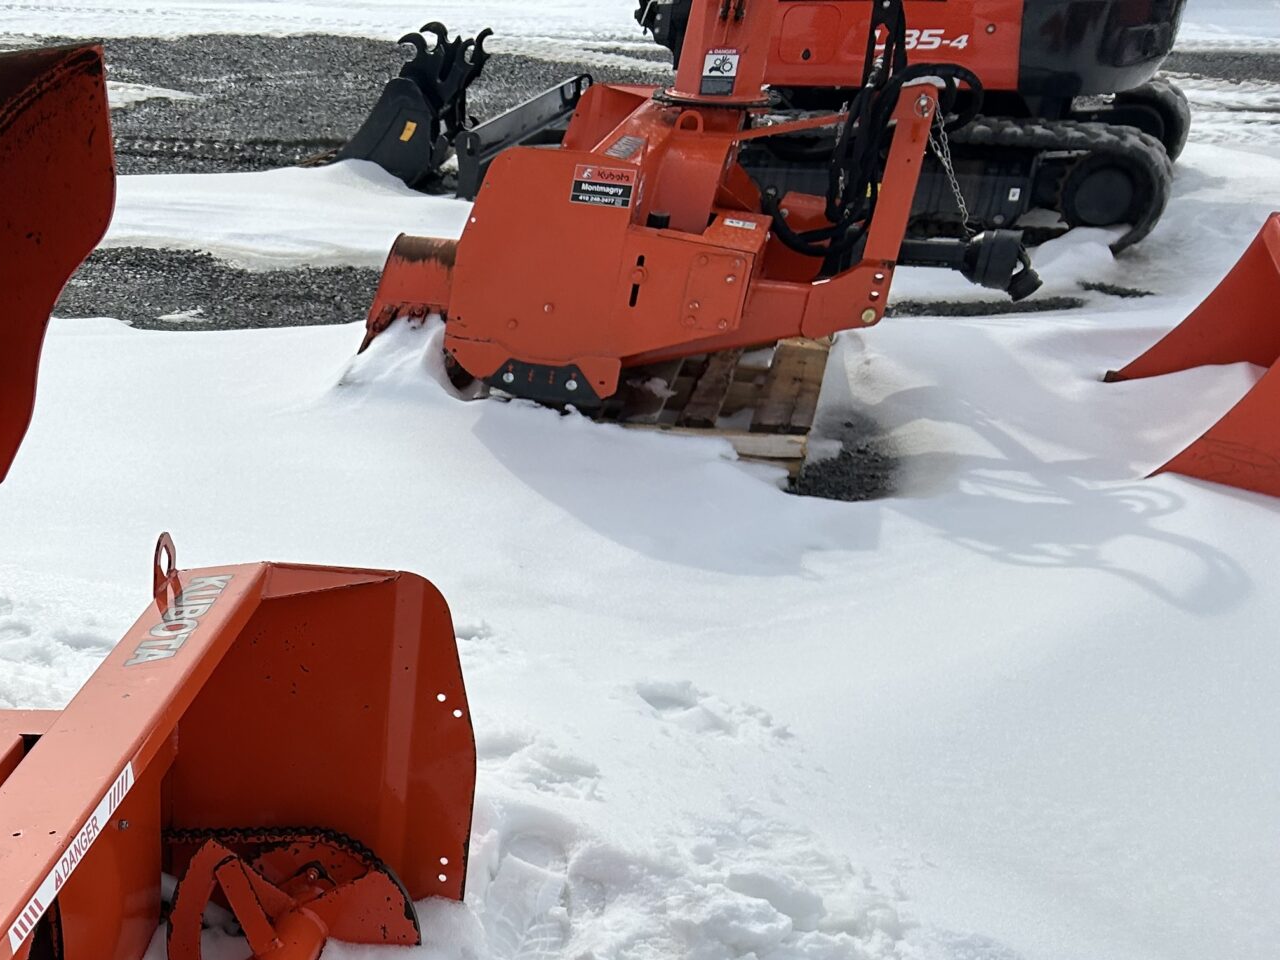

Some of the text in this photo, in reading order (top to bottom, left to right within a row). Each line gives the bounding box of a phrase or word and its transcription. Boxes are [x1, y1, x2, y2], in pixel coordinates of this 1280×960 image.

[581, 183, 624, 196] Montmagny
[597, 170, 630, 181] Kubota
[123, 574, 234, 667] KUBOTA
[61, 815, 100, 879] DANGER
